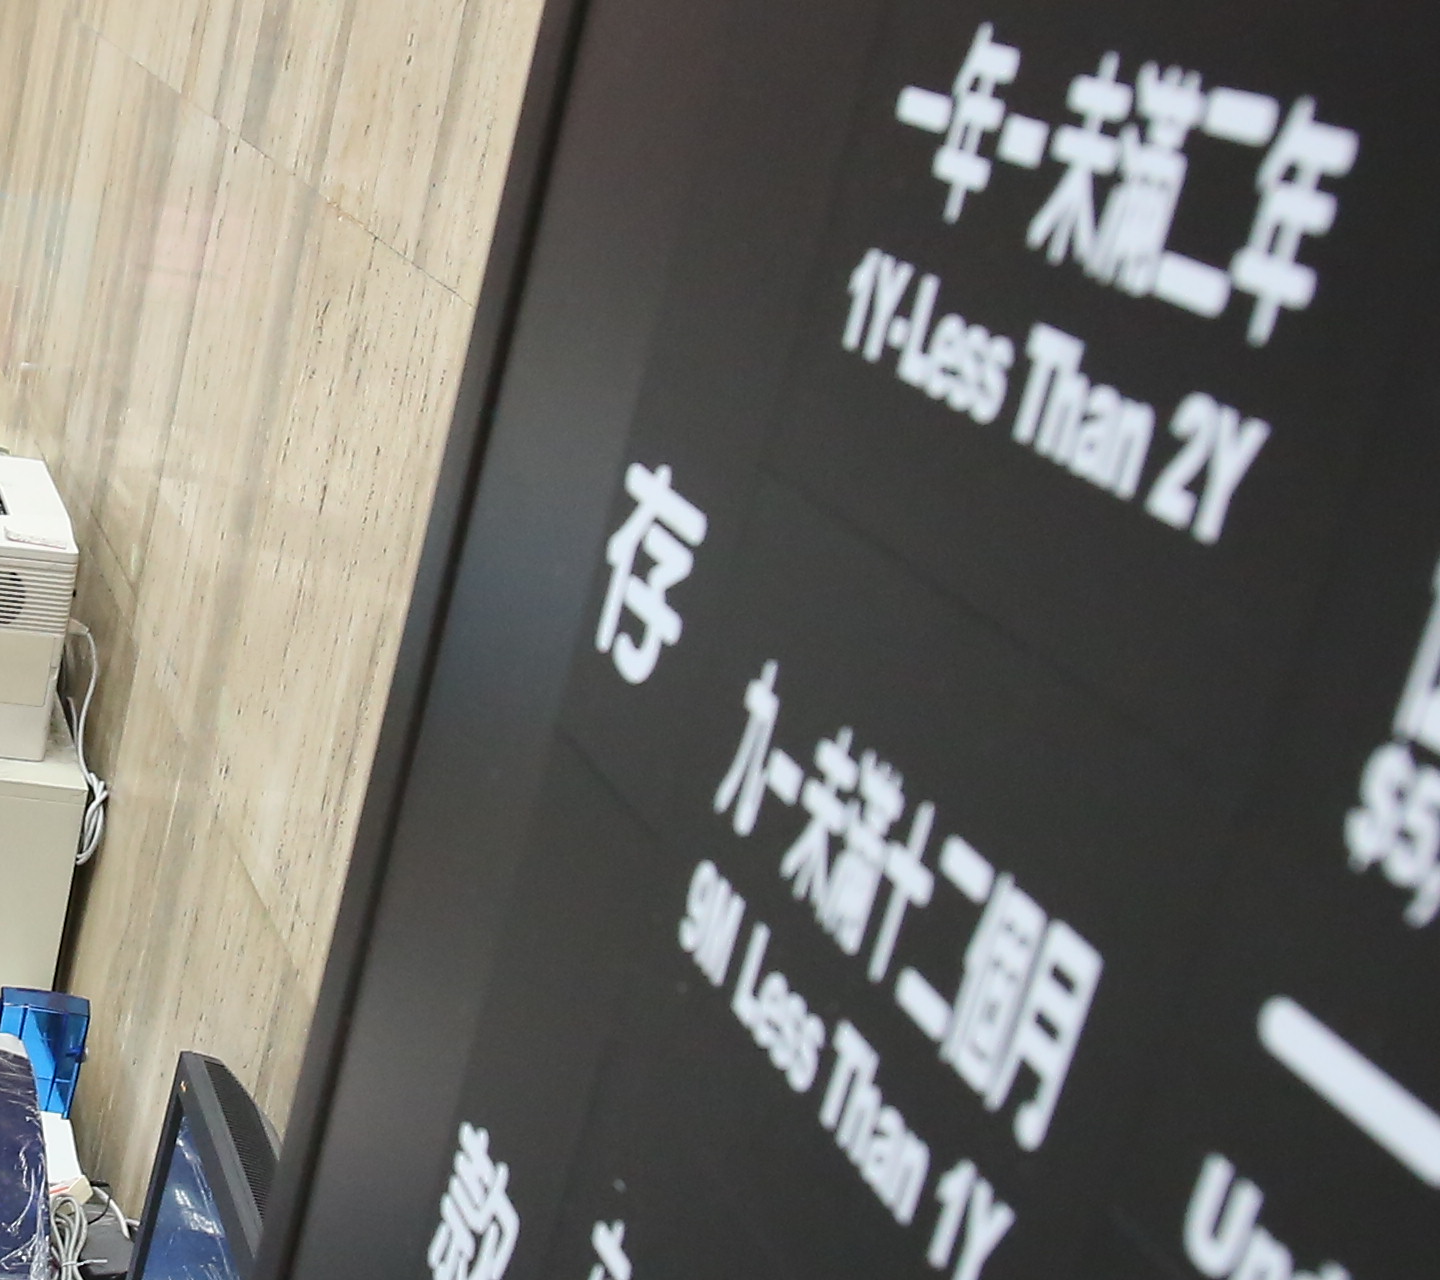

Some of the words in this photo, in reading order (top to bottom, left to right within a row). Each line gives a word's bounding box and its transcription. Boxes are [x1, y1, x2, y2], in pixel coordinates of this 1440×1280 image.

[840, 247, 1014, 423] 1Y-Less
[1012, 321, 1154, 501] Than
[1145, 391, 1271, 544] 2Y
[596, 463, 708, 684] 存
[818, 1020, 931, 1224] Than
